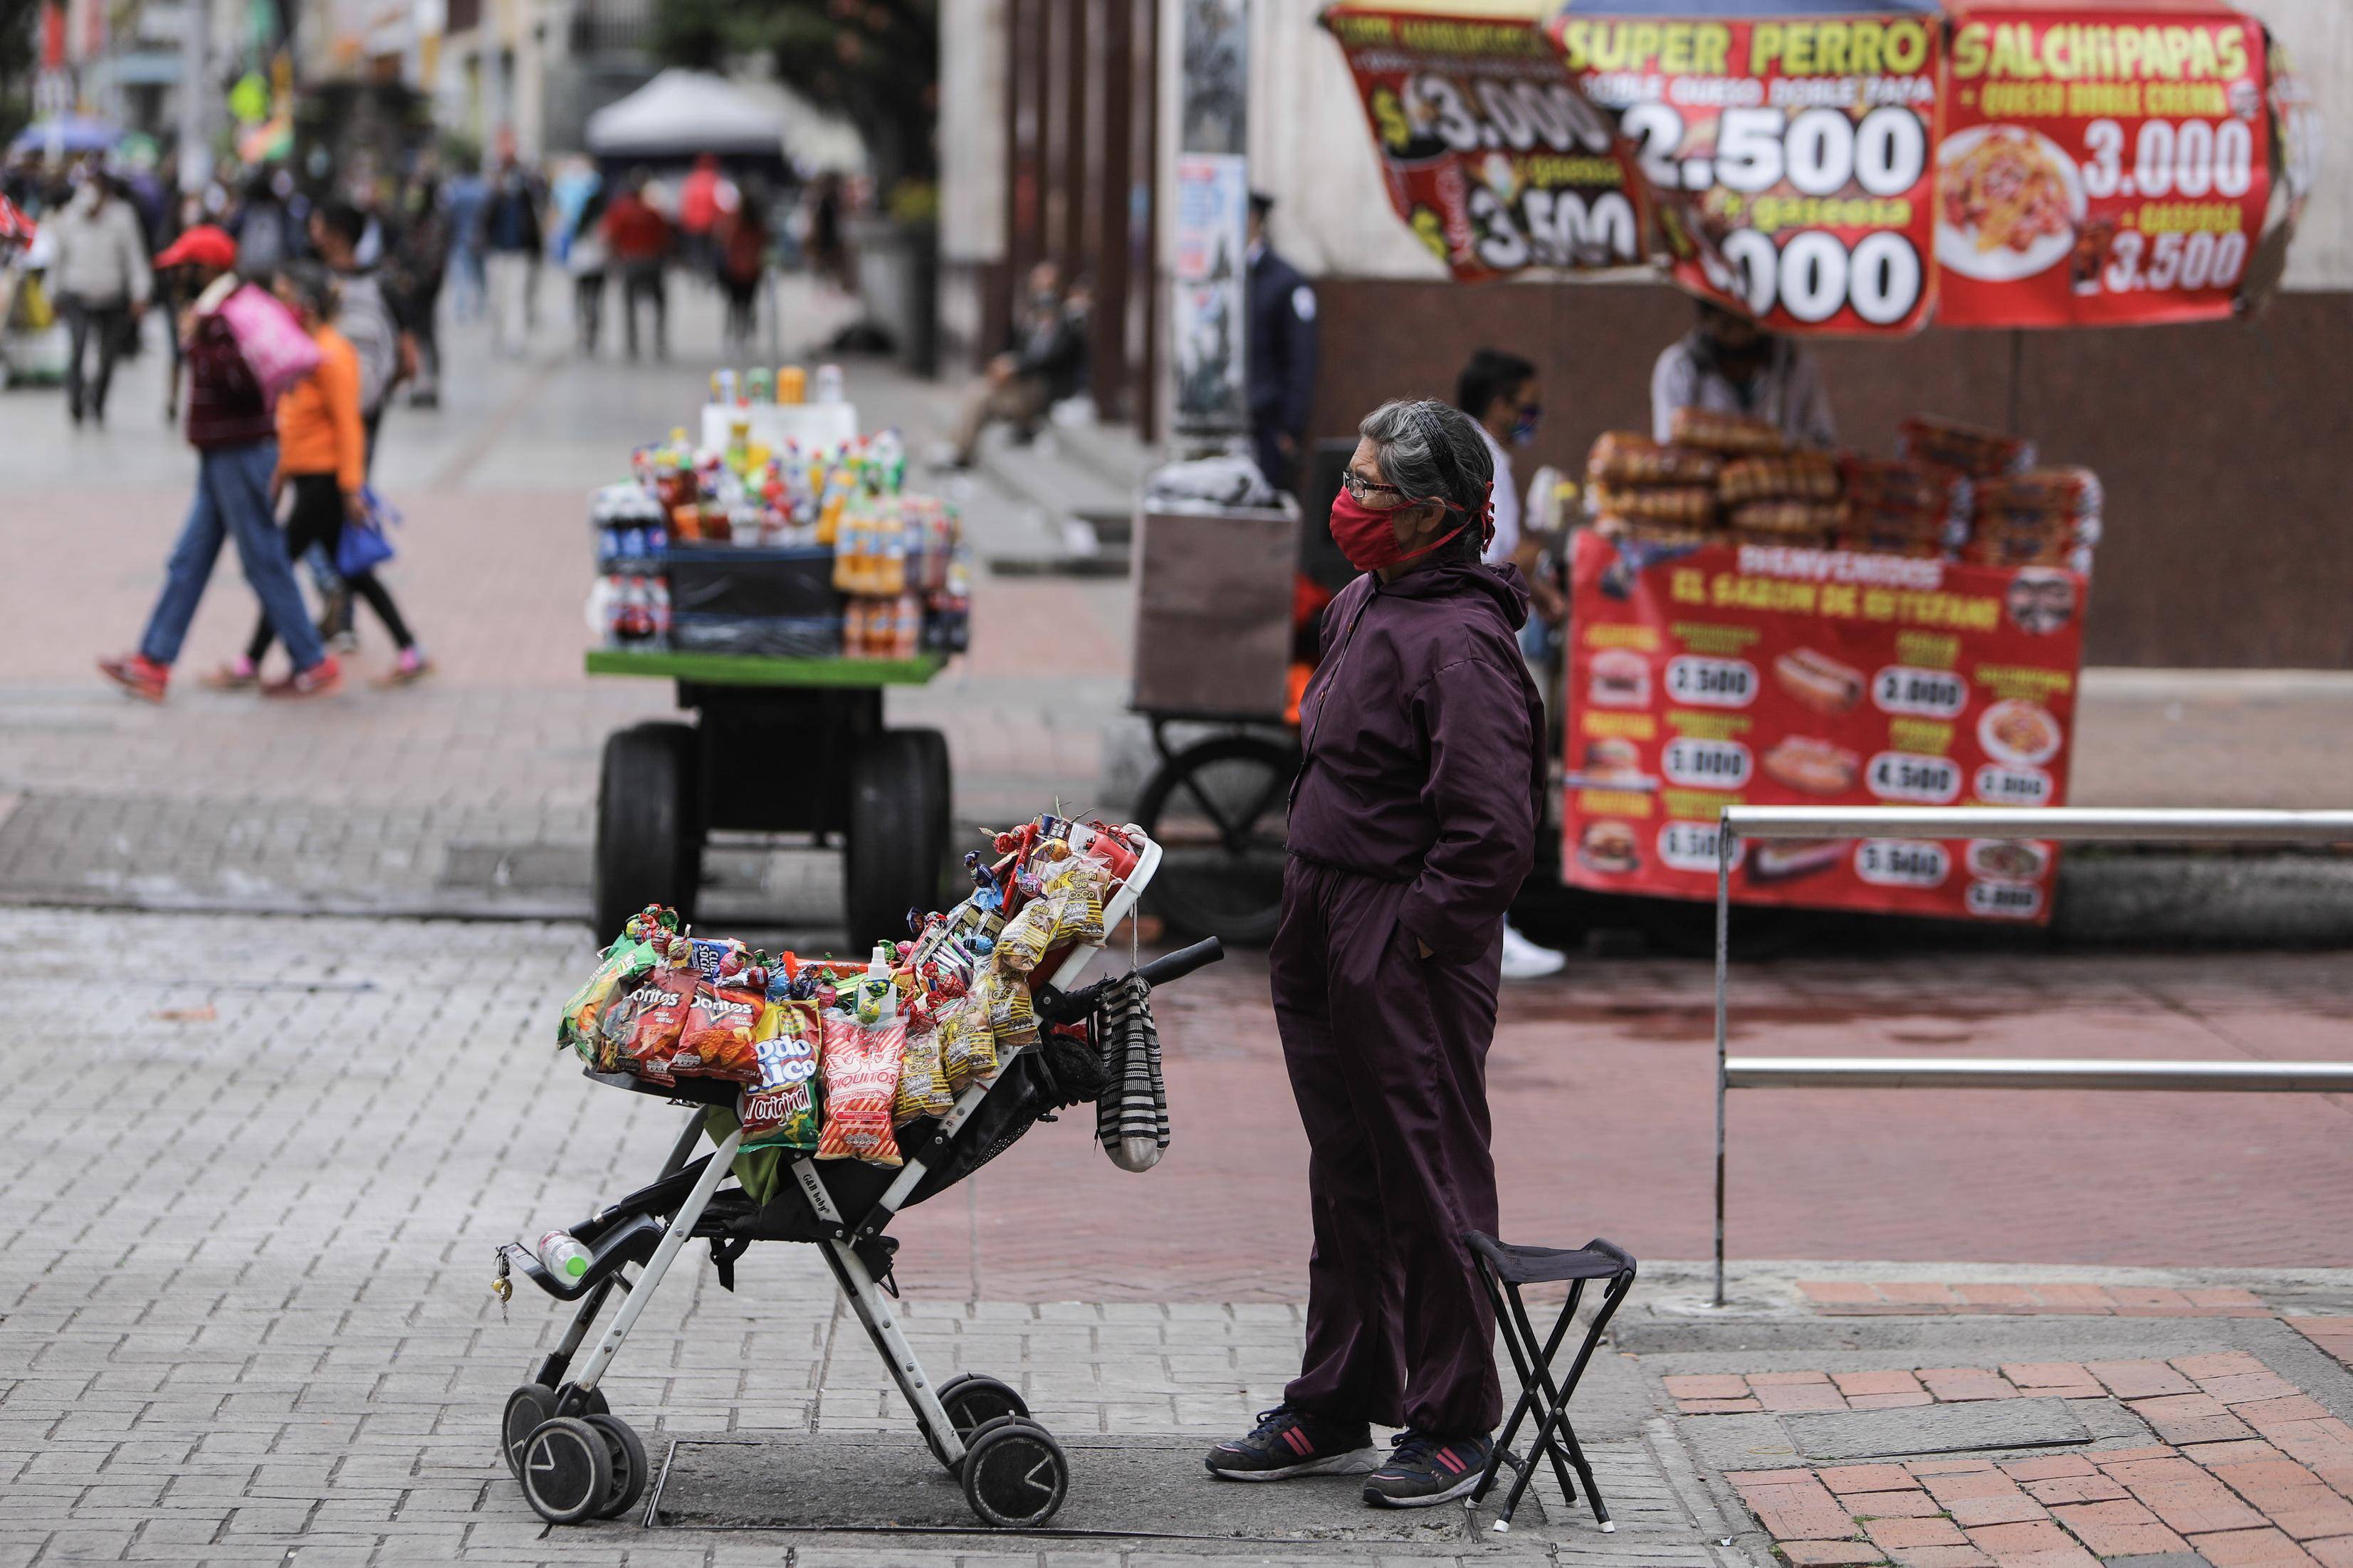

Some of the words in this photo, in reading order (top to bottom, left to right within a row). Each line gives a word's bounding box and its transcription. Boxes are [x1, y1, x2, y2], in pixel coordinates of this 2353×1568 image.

[1568, 21, 1729, 74] SUPER
[1751, 18, 1928, 75] PERRO
[1620, 102, 1926, 197] 2.500
[2081, 118, 2253, 198] 3.000
[2105, 230, 2248, 293] 3.500
[1076, 880, 1088, 889] de
[625, 989, 680, 1006] oritos
[754, 1034, 811, 1061] odo
[830, 1071, 897, 1091] PIQUITOS
[802, 1174, 817, 1192] G&B
